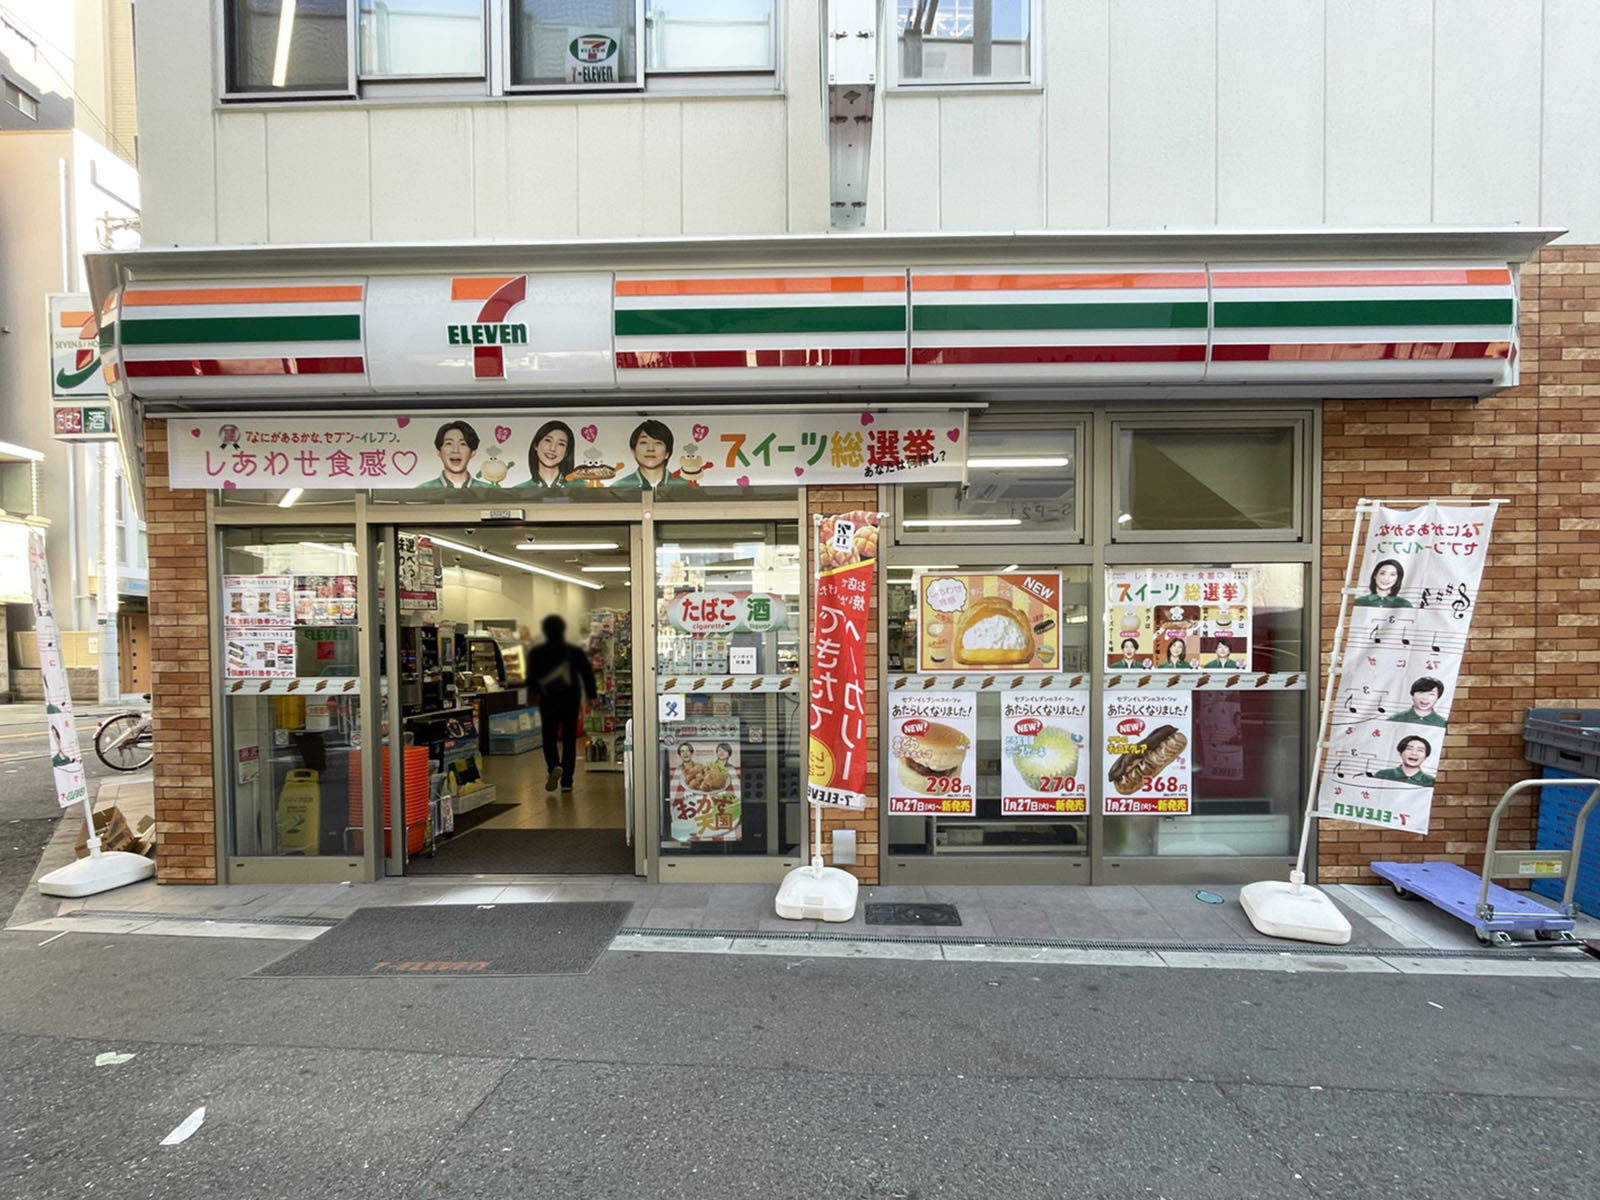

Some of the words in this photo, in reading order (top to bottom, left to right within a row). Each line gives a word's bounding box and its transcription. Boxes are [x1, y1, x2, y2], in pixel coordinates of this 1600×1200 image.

[88, 411, 105, 430] 酒
[719, 428, 935, 470] スイーツ総選挙
[1022, 576, 1055, 600] NEW
[1116, 582, 1239, 602] スイーツ総選挙
[682, 597, 736, 622] たばこ
[747, 598, 771, 622] 酒
[892, 705, 972, 717] あたらしくなりました!
[1004, 704, 1086, 716] あたらしくなりました!
[1107, 704, 1188, 716] あたらしくなりました!
[903, 722, 928, 733] NEW!
[1016, 722, 1040, 733] NEW!
[1119, 722, 1143, 733] NEW!
[926, 777, 971, 793] 298円
[1040, 777, 1085, 793] 270円
[1142, 777, 1187, 793] 368円
